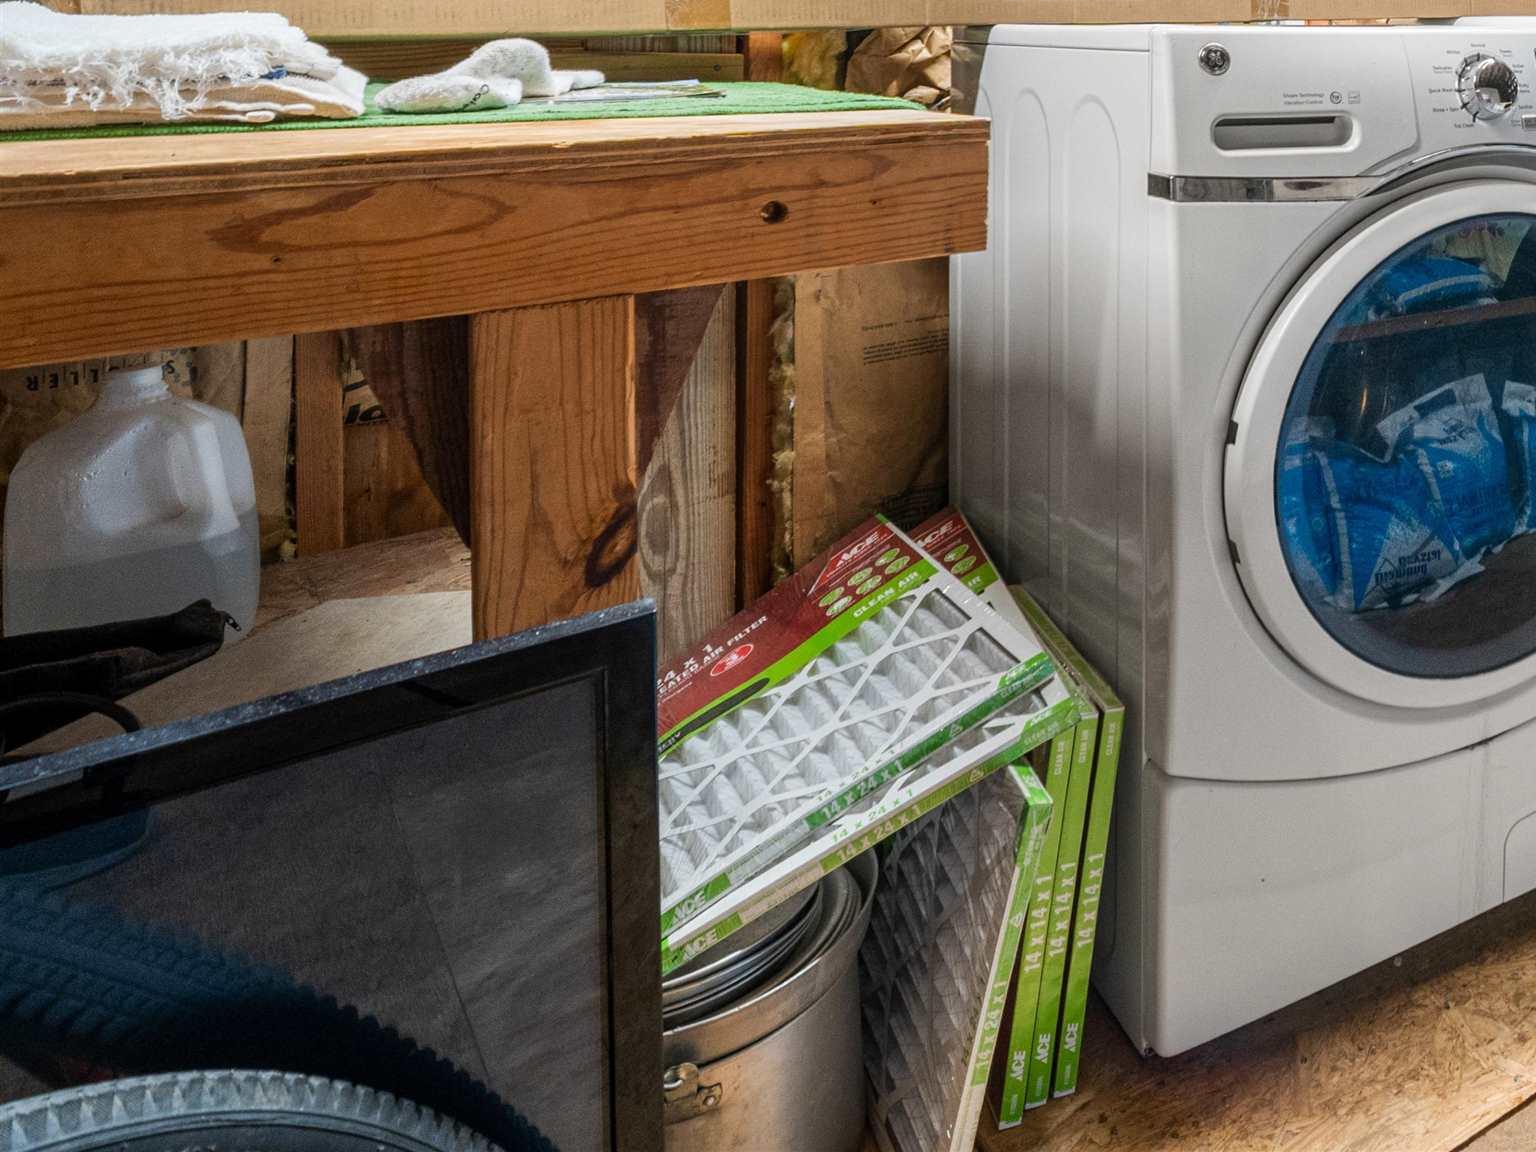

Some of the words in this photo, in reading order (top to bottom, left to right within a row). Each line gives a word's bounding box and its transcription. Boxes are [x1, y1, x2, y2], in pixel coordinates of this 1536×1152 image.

[853, 588, 895, 619] CLEAN
[897, 571, 921, 588] AIR
[703, 647, 725, 666] AIR
[727, 615, 768, 647] FILTER
[1035, 1033, 1051, 1065] ACE
[1064, 1023, 1079, 1054] ACE
[1010, 1050, 1026, 1082] ACE
